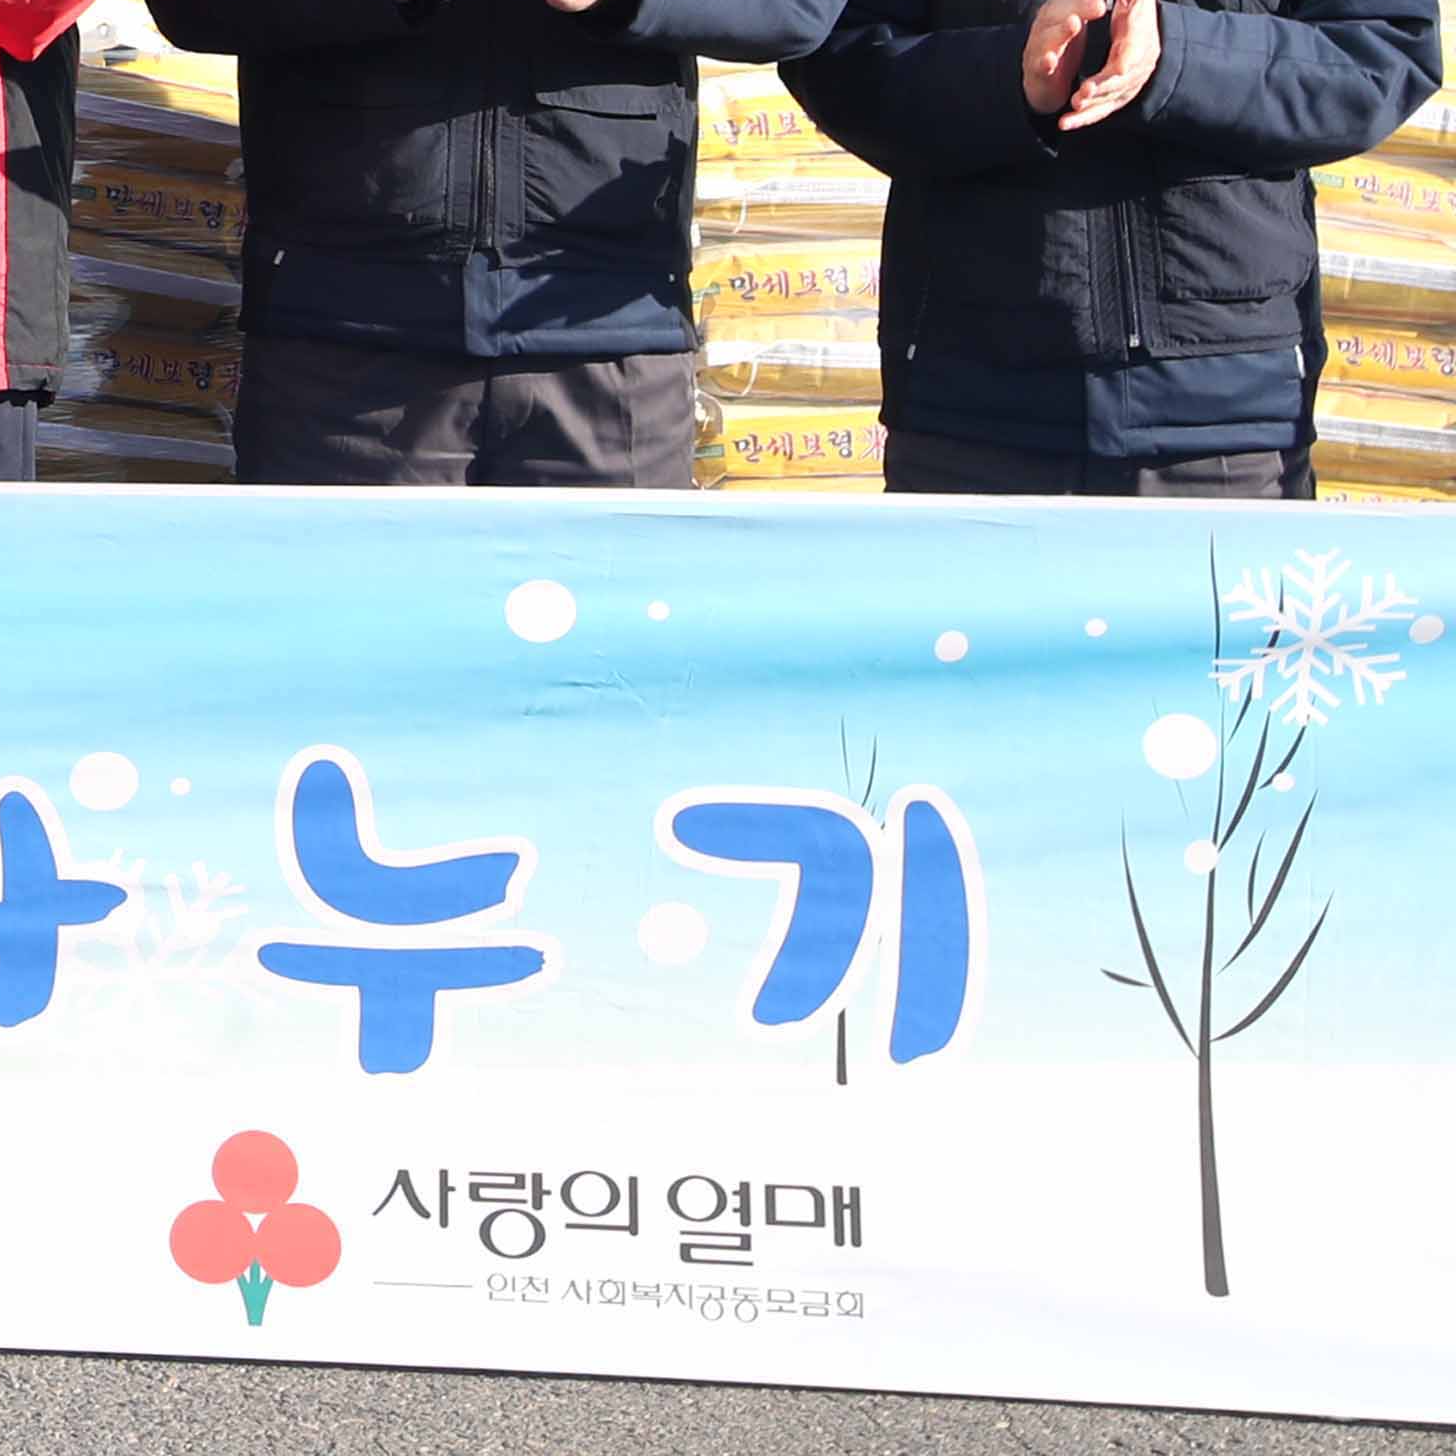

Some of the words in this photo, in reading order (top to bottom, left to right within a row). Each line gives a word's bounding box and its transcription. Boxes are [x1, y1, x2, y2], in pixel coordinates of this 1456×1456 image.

[712, 110, 818, 146] 만세보
[372, 1169, 639, 1260] 사랑의
[666, 1175, 864, 1267] 열매
[486, 1273, 551, 1305] 인천
[561, 1276, 866, 1323] 사회복지공동모금회
